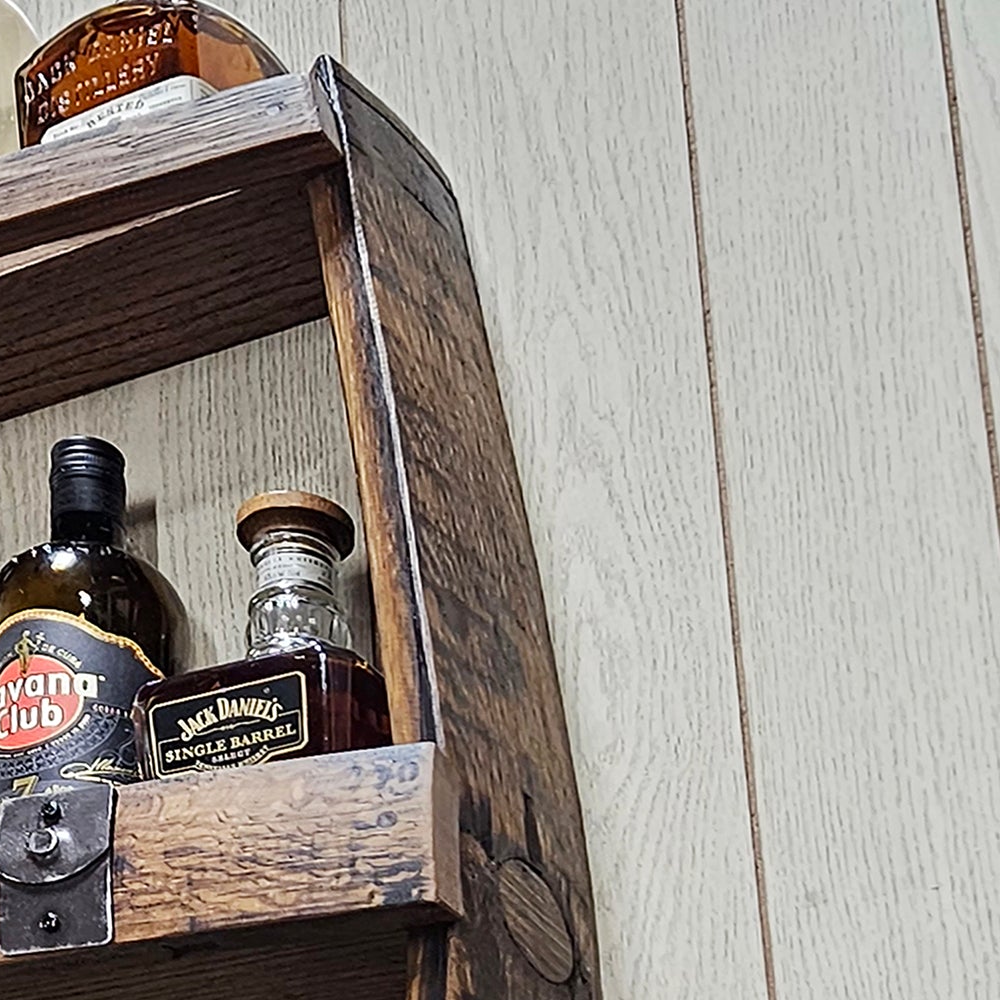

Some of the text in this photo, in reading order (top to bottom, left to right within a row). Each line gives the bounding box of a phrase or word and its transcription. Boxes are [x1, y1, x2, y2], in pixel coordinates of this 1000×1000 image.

[177, 696, 284, 742] JACK DANIEL'S
[165, 722, 297, 764] SINGLE BARREL
